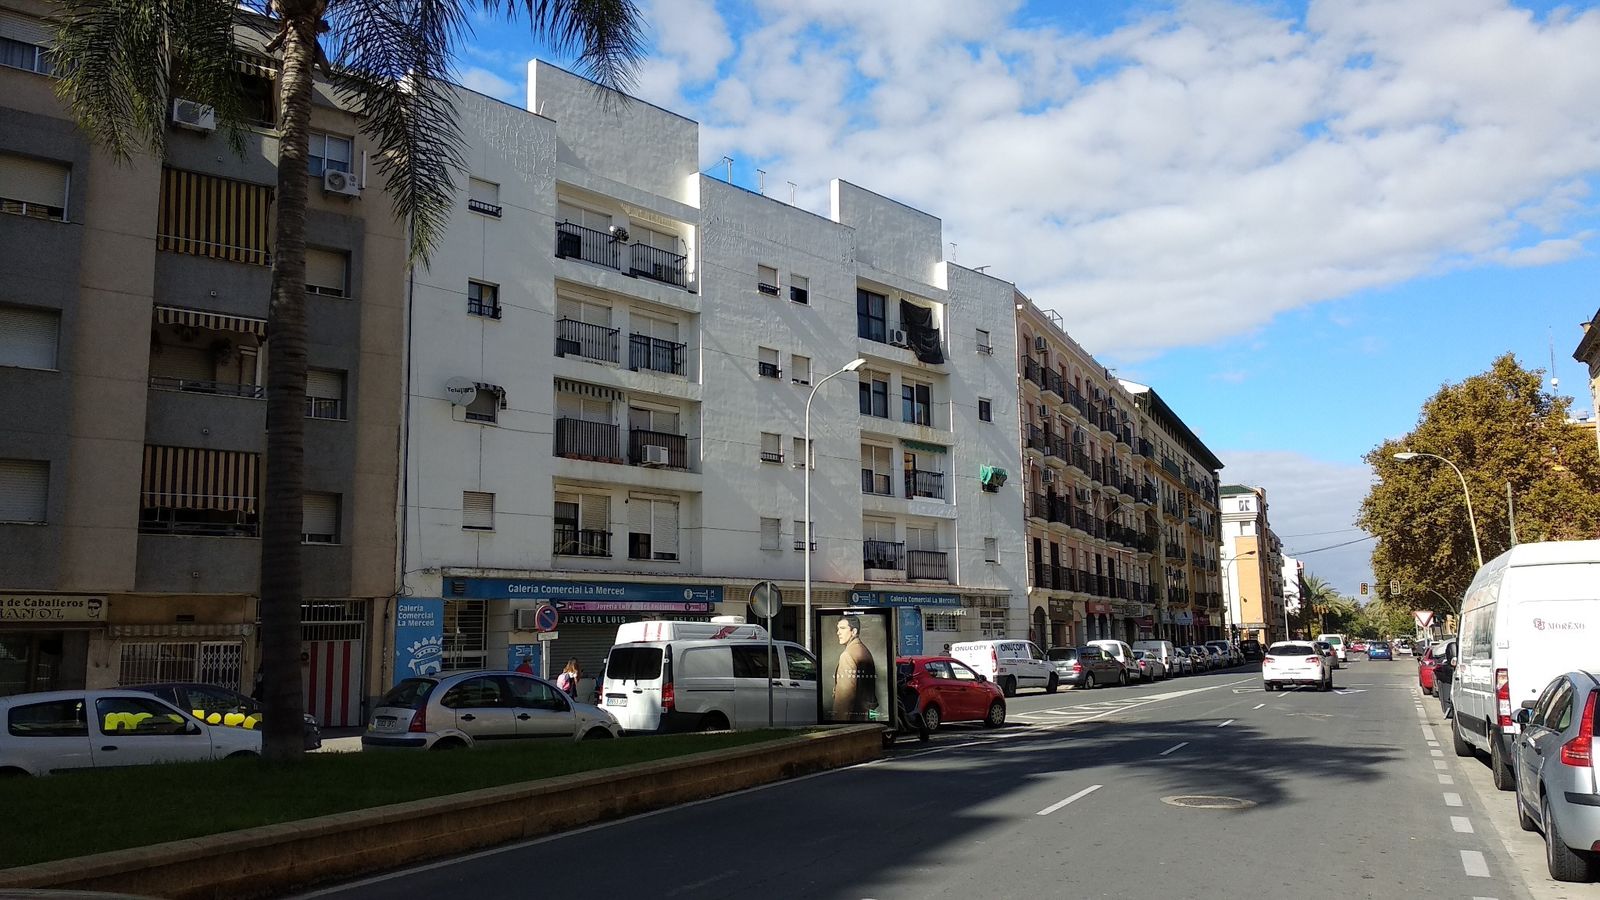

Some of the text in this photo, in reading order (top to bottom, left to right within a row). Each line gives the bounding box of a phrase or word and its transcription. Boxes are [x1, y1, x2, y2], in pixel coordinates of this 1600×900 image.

[541, 585, 582, 594] Comercial
[584, 586, 594, 594] La
[596, 586, 625, 595] Merced
[7, 598, 21, 607] de
[23, 598, 84, 608] Caballeros
[563, 616, 626, 624] JOYERIA LUIS
[954, 644, 988, 652] ONUCOPY
[1000, 643, 1026, 652] ONUCOPY
